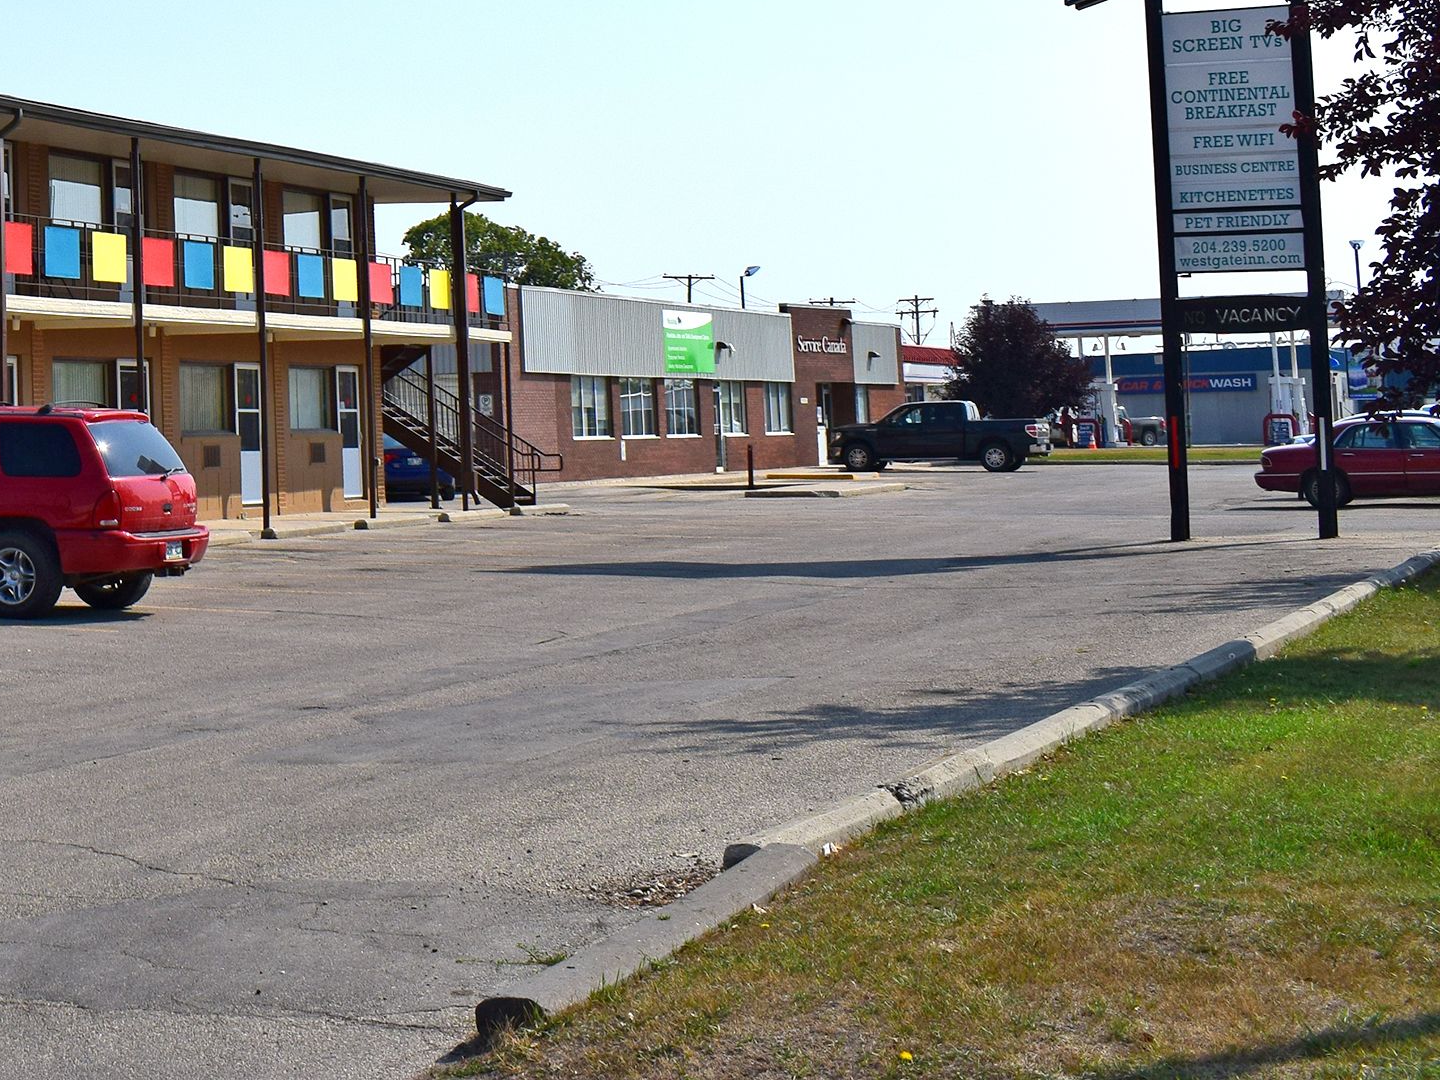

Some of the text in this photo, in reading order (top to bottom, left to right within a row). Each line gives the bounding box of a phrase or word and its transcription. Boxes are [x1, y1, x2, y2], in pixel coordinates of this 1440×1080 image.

[1210, 19, 1242, 34] BIG
[1172, 34, 1283, 53] SCREEN TVs
[1208, 71, 1249, 86] FREE
[1171, 86, 1290, 104] CONTINENTAL
[1185, 103, 1277, 120] BREAKFAST
[1193, 133, 1274, 149] FREE WIFI
[1175, 160, 1295, 176] BUSINESS CENTRE
[1179, 188, 1295, 204] KITCHENETTES
[1184, 214, 1290, 229] PET FRIENDLY
[1192, 239, 1286, 254] 204.239.5200
[1179, 253, 1301, 269] westgateinn.com
[1215, 306, 1301, 324] VACANCY
[797, 334, 847, 354] Service Canada
[1121, 380, 1148, 391] CAR
[1209, 377, 1252, 388] WASH
